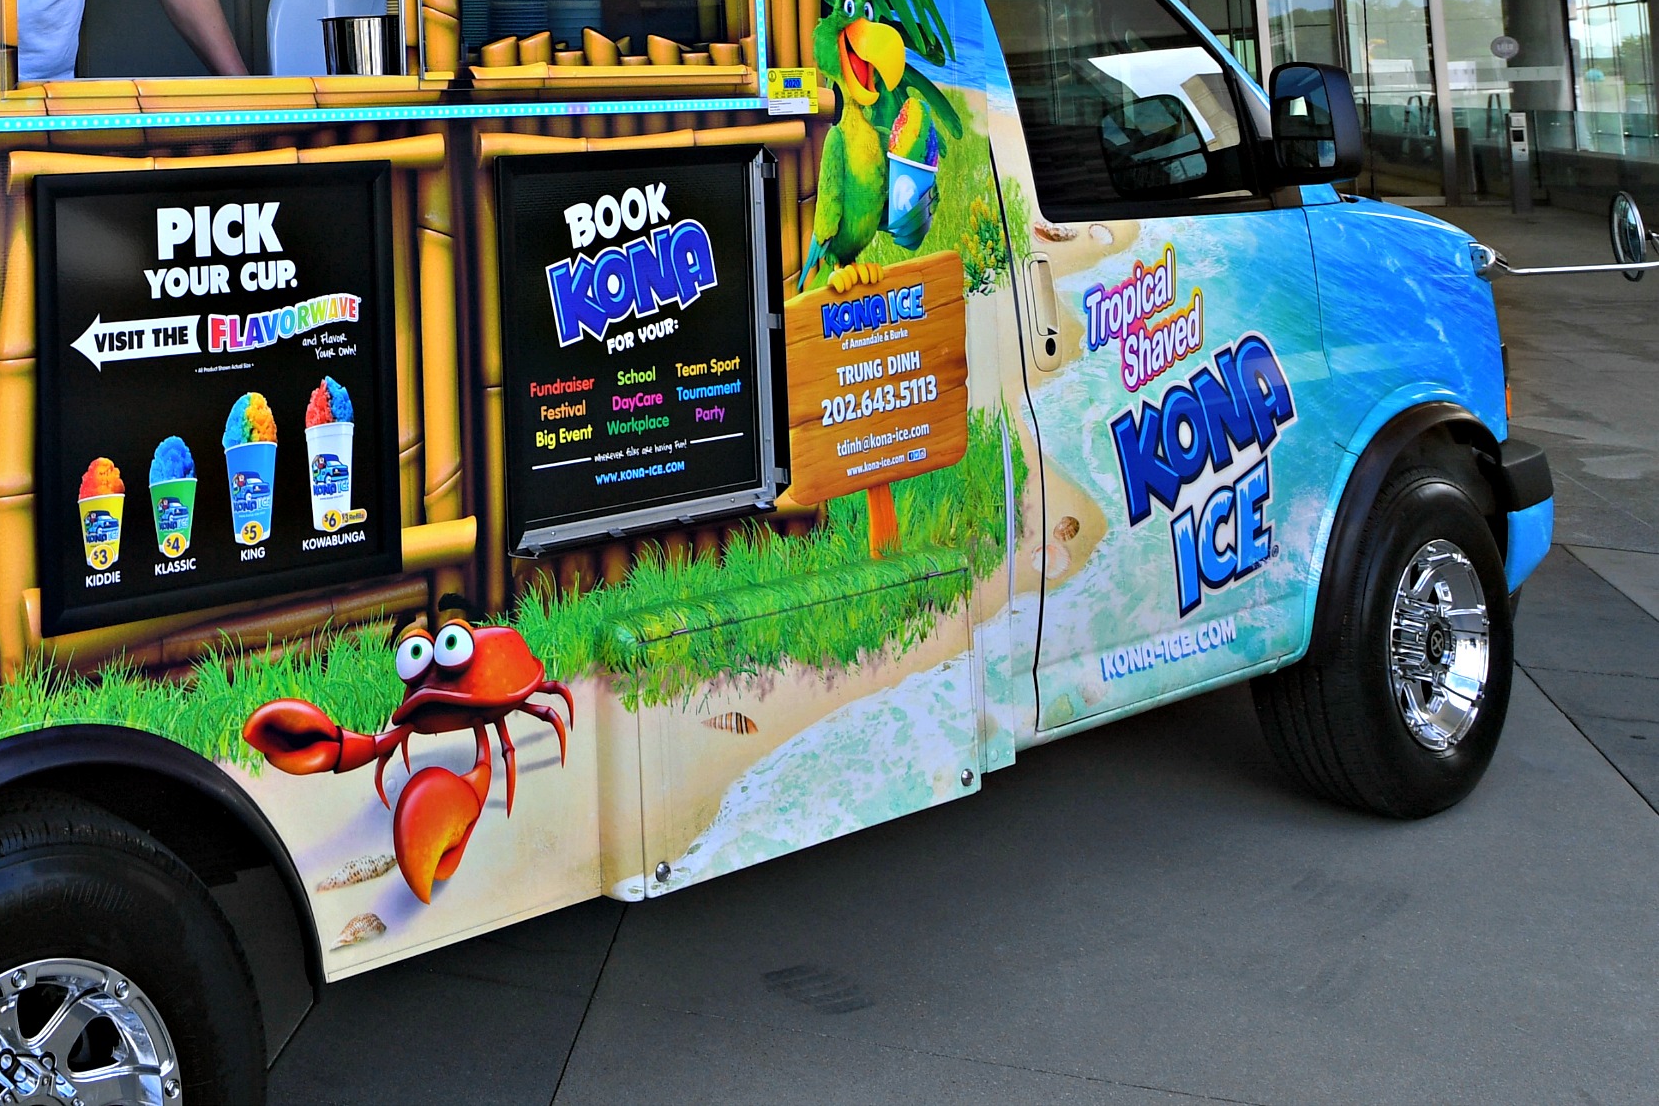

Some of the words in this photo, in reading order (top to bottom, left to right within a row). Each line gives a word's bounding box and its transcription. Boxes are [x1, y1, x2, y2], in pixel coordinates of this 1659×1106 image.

[563, 181, 671, 249] BOOK
[156, 201, 283, 260] PICK
[143, 265, 230, 299] YOUR
[240, 260, 298, 292] CUP.
[546, 220, 717, 347] KONA
[1085, 248, 1173, 347] Tropical
[822, 294, 887, 339] KONA
[887, 284, 925, 323] ICE
[94, 329, 145, 353] VISIT
[152, 325, 188, 348] THE
[210, 295, 357, 351] FLAVORWAVE
[302, 334, 317, 346] and
[606, 331, 634, 355] FOR
[638, 317, 679, 343] YOUR:
[841, 337, 849, 350] of
[850, 333, 883, 349] Annandale
[884, 332, 889, 341] &
[890, 328, 908, 340] Burke
[1122, 290, 1201, 389] Shaved
[617, 366, 656, 385] School
[675, 363, 707, 377] Team
[710, 356, 740, 375] Sport
[836, 359, 882, 386] TRUNG
[887, 351, 920, 375] DINH
[530, 376, 595, 398] Fundraiser
[676, 379, 741, 401] Tournament
[541, 399, 586, 421] Festival
[612, 392, 663, 412] DayCare
[821, 375, 938, 426] 202.643.5113
[695, 406, 725, 422] Party
[535, 429, 556, 449] Big
[559, 424, 593, 444] Event
[607, 415, 670, 436] Workplace
[1109, 333, 1295, 527] KONA
[836, 423, 930, 457] tdinh@kona-ice.com
[846, 454, 905, 477] www.kona-ice.com
[324, 513, 337, 527] $6
[244, 525, 257, 540] $5
[302, 530, 366, 551] KOWABUNGA
[1172, 455, 1273, 616] ICE
[166, 537, 180, 553] $4
[240, 547, 266, 562] KING
[93, 549, 108, 565] $3
[154, 558, 196, 576] KLASSIC
[85, 571, 121, 588] KIDDIE
[1101, 618, 1236, 682] KONA-ICE.COM
